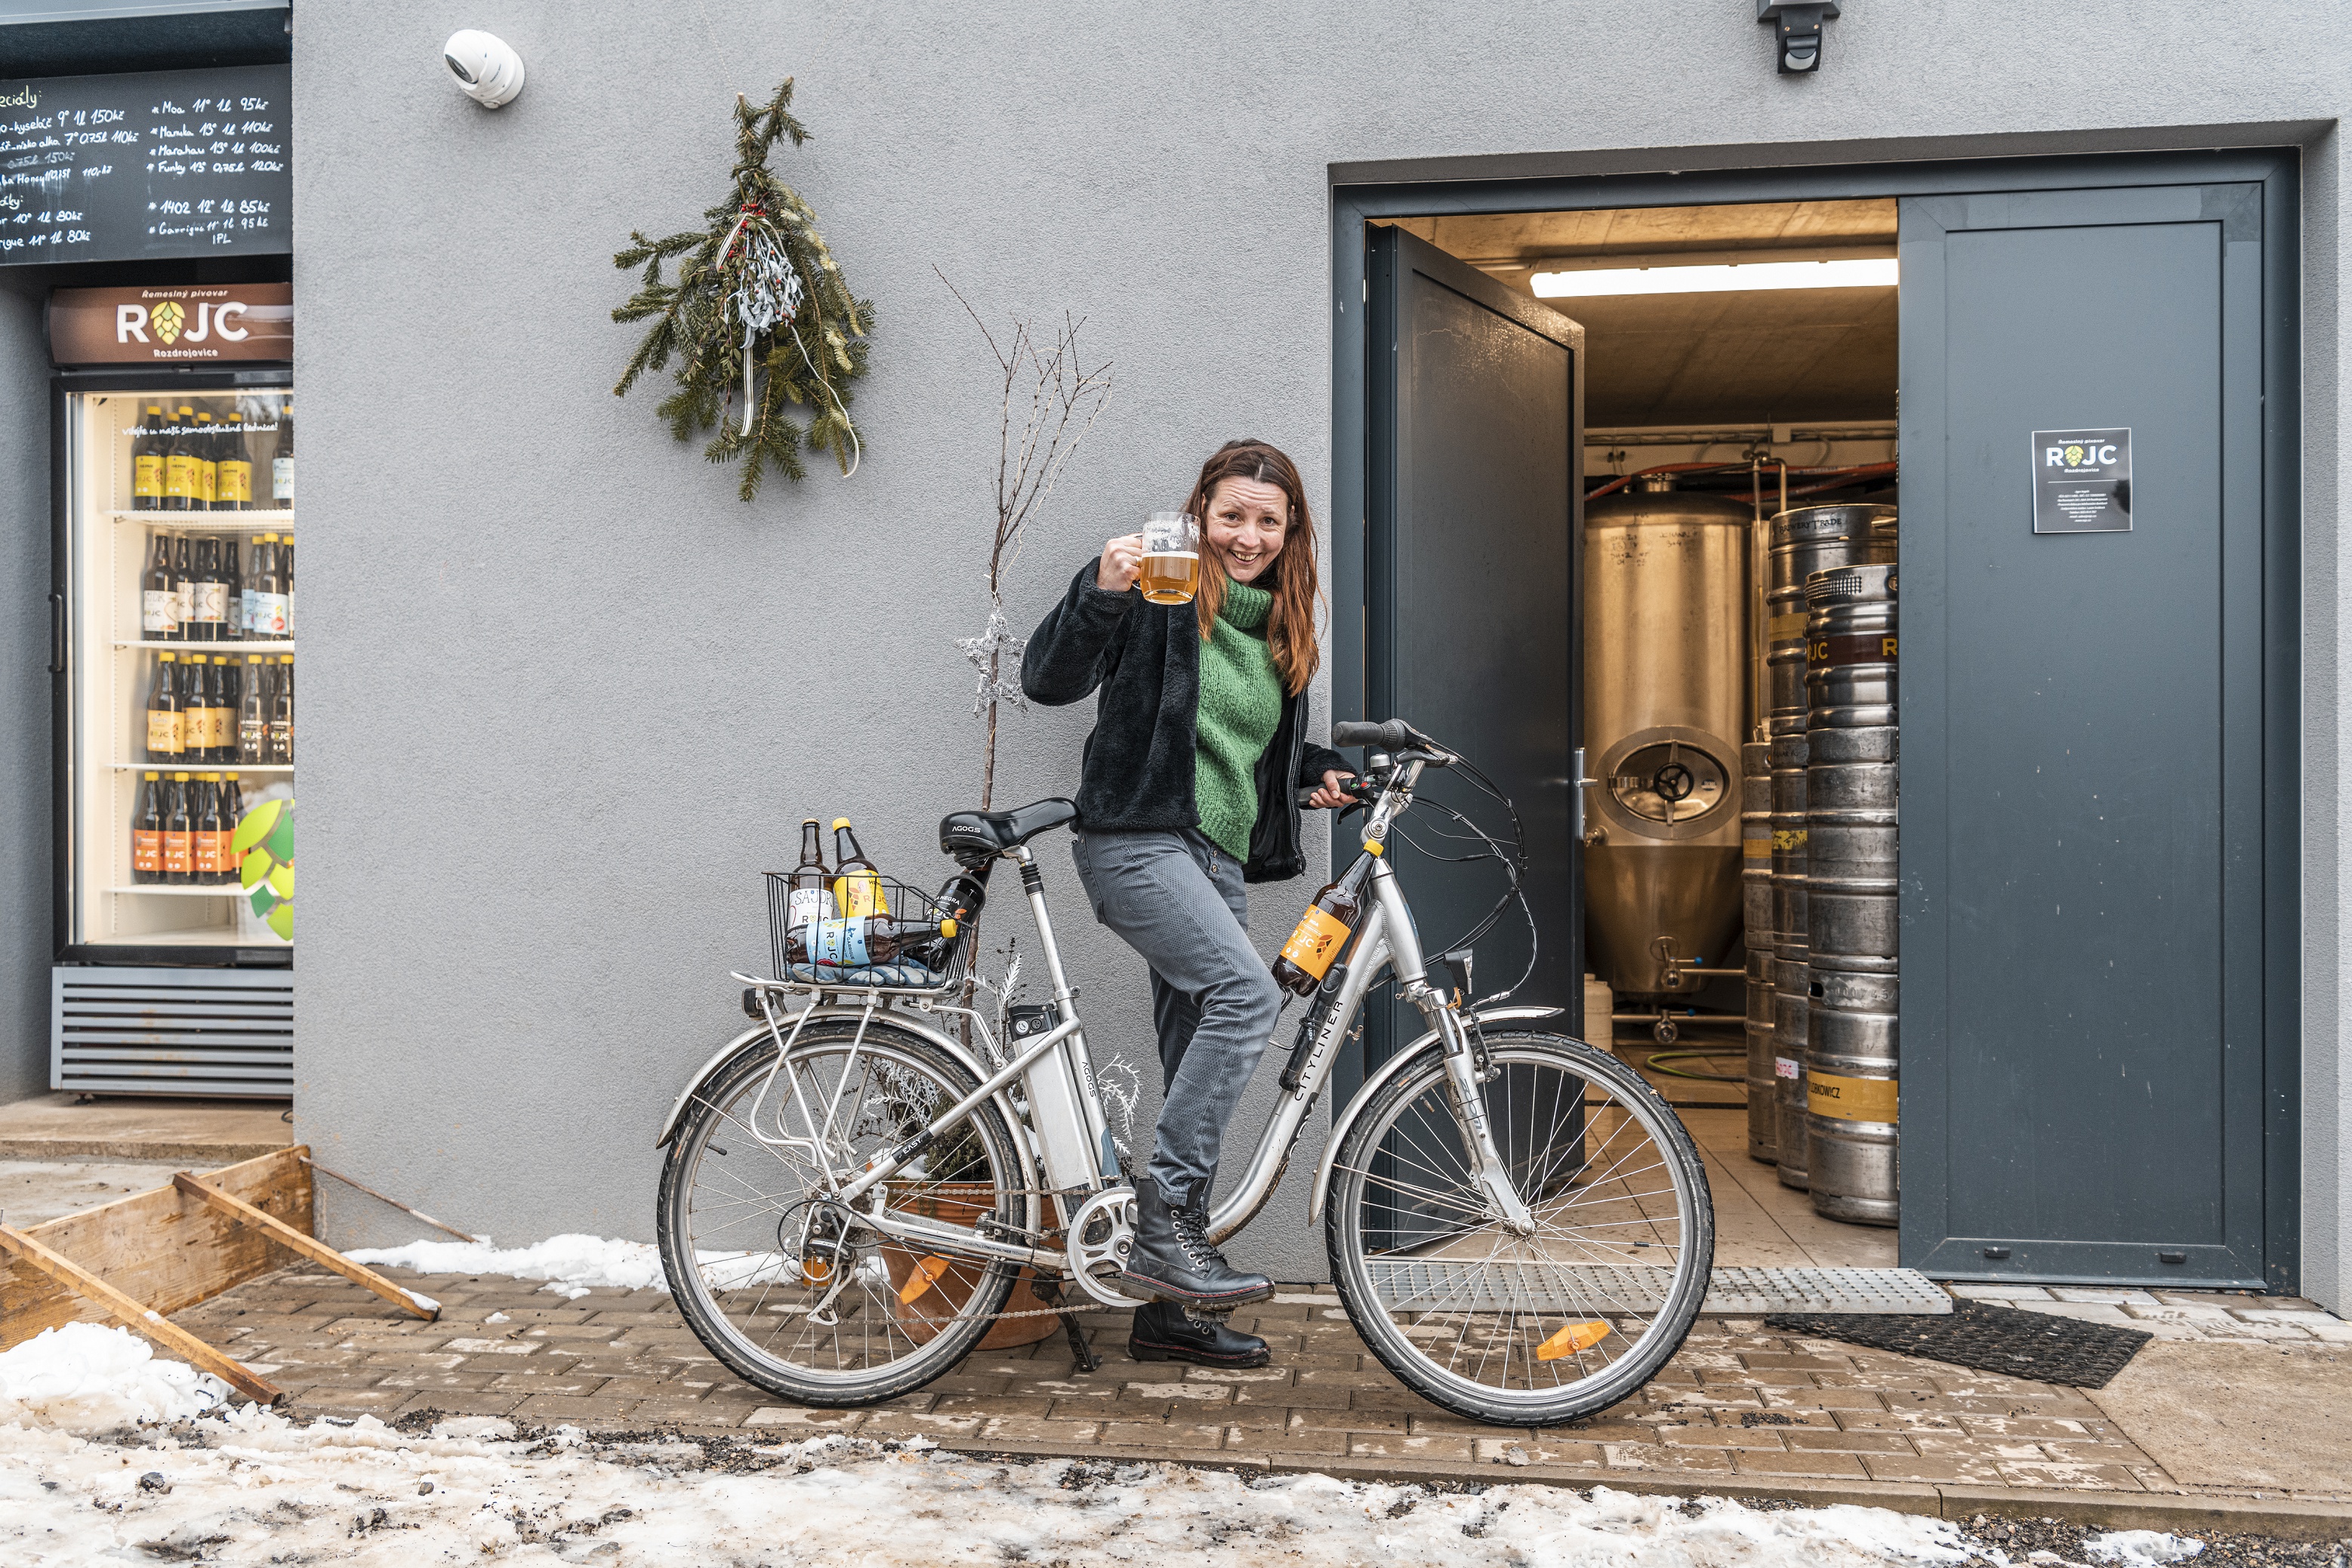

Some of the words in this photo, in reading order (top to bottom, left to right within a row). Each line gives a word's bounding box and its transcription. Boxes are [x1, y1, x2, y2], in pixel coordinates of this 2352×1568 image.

[162, 101, 185, 113] Moa
[240, 97, 269, 111] 95kč
[91, 109, 125, 125] 150kč
[242, 121, 273, 134] 110kč
[111, 130, 139, 144] 110kč
[158, 144, 205, 156] Marahau
[249, 141, 281, 154] 100kč
[158, 160, 186, 175] Funky
[251, 160, 284, 172] 120kč
[160, 199, 191, 214] 1402
[239, 199, 270, 214] 85kč
[56, 210, 83, 222] 80kč
[66, 230, 91, 243] 80kč
[212, 233, 232, 245] IPL
[141, 290, 188, 299] Řemeslný
[190, 290, 228, 298] pivovar
[116, 301, 249, 345] ROJC
[153, 348, 219, 359] Rozdrojovice
[2045, 445, 2117, 467] ROJC
[1811, 518, 1842, 530] TRADE
[951, 825, 982, 833] AGOGS
[794, 890, 833, 907] SAJDR
[940, 895, 960, 905] NEGRA
[846, 937, 855, 960] GARRIGUE
[1294, 1000, 1343, 1101] CITYLINER
[1081, 1061, 1096, 1098] AGOGS
[902, 1137, 921, 1154] EASY
